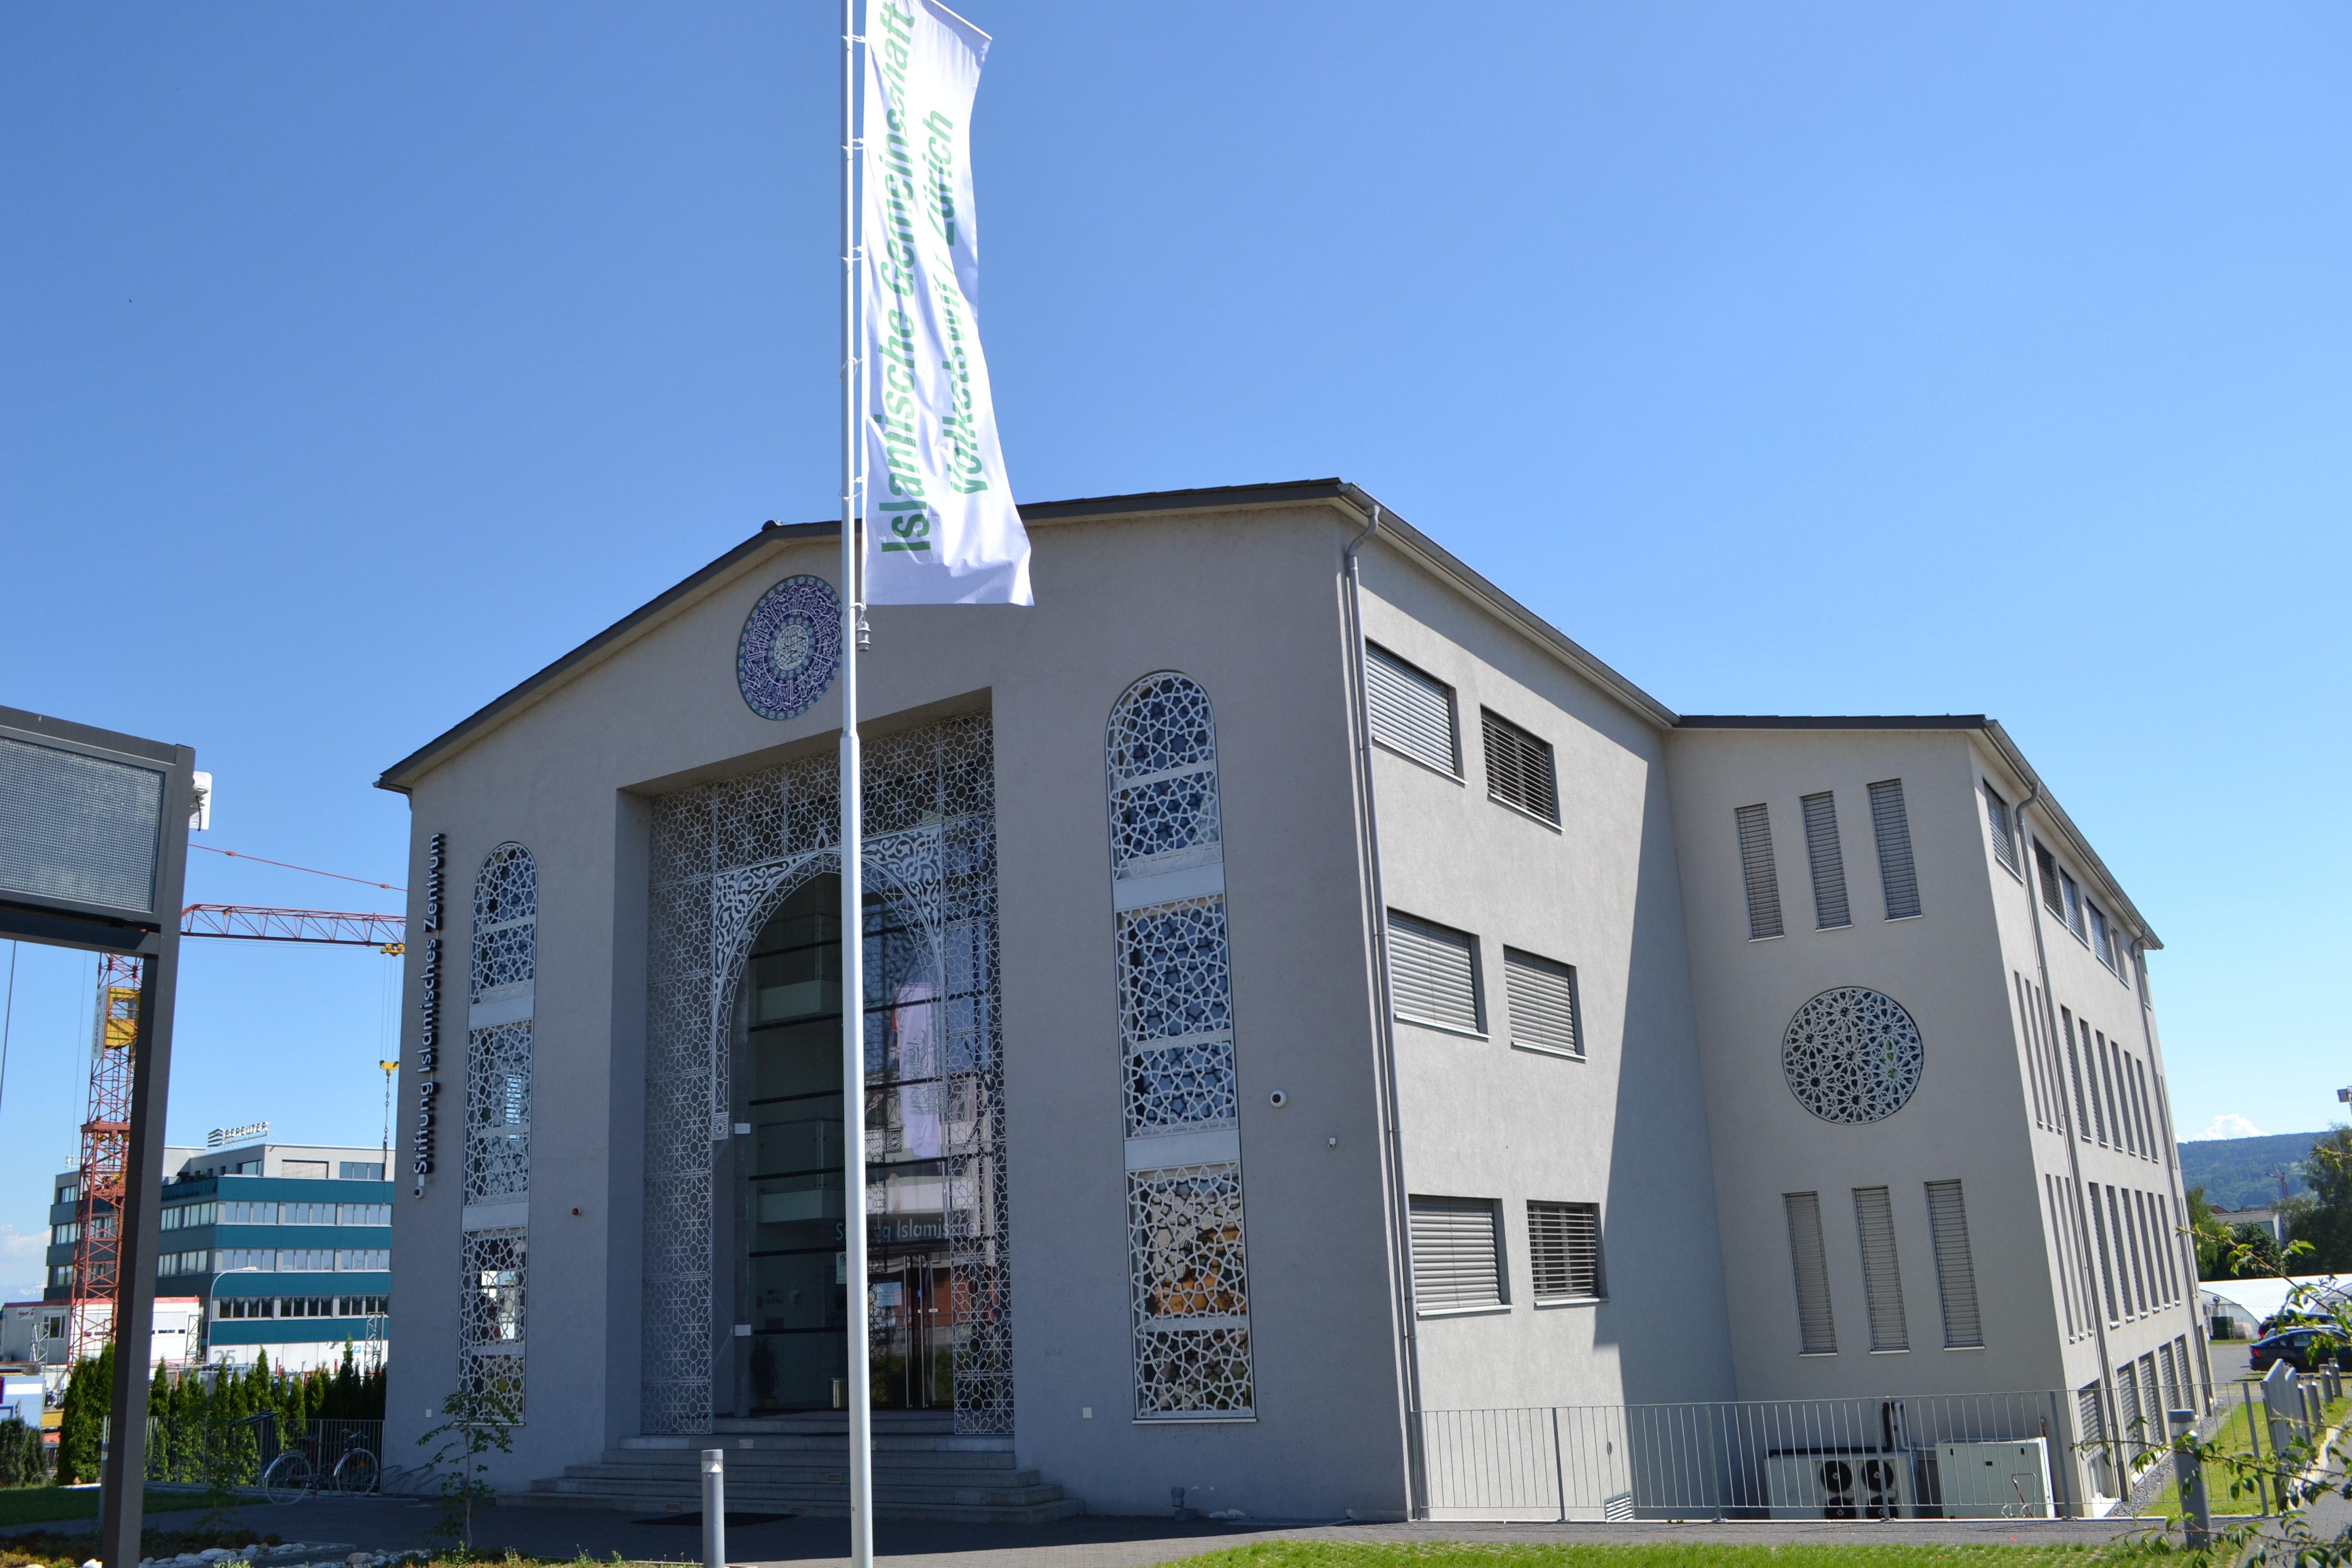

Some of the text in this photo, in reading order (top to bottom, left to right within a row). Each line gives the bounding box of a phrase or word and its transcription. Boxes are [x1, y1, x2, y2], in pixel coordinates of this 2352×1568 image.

[922, 110, 955, 246] Zürich
[873, 1, 932, 553] Islamische Gemeinschaft
[933, 272, 988, 494] Volketswil
[413, 833, 441, 1175] Stiftung Islamisches Zentrum
[225, 1122, 267, 1139] BEREUTER
[214, 1350, 236, 1364] 25
